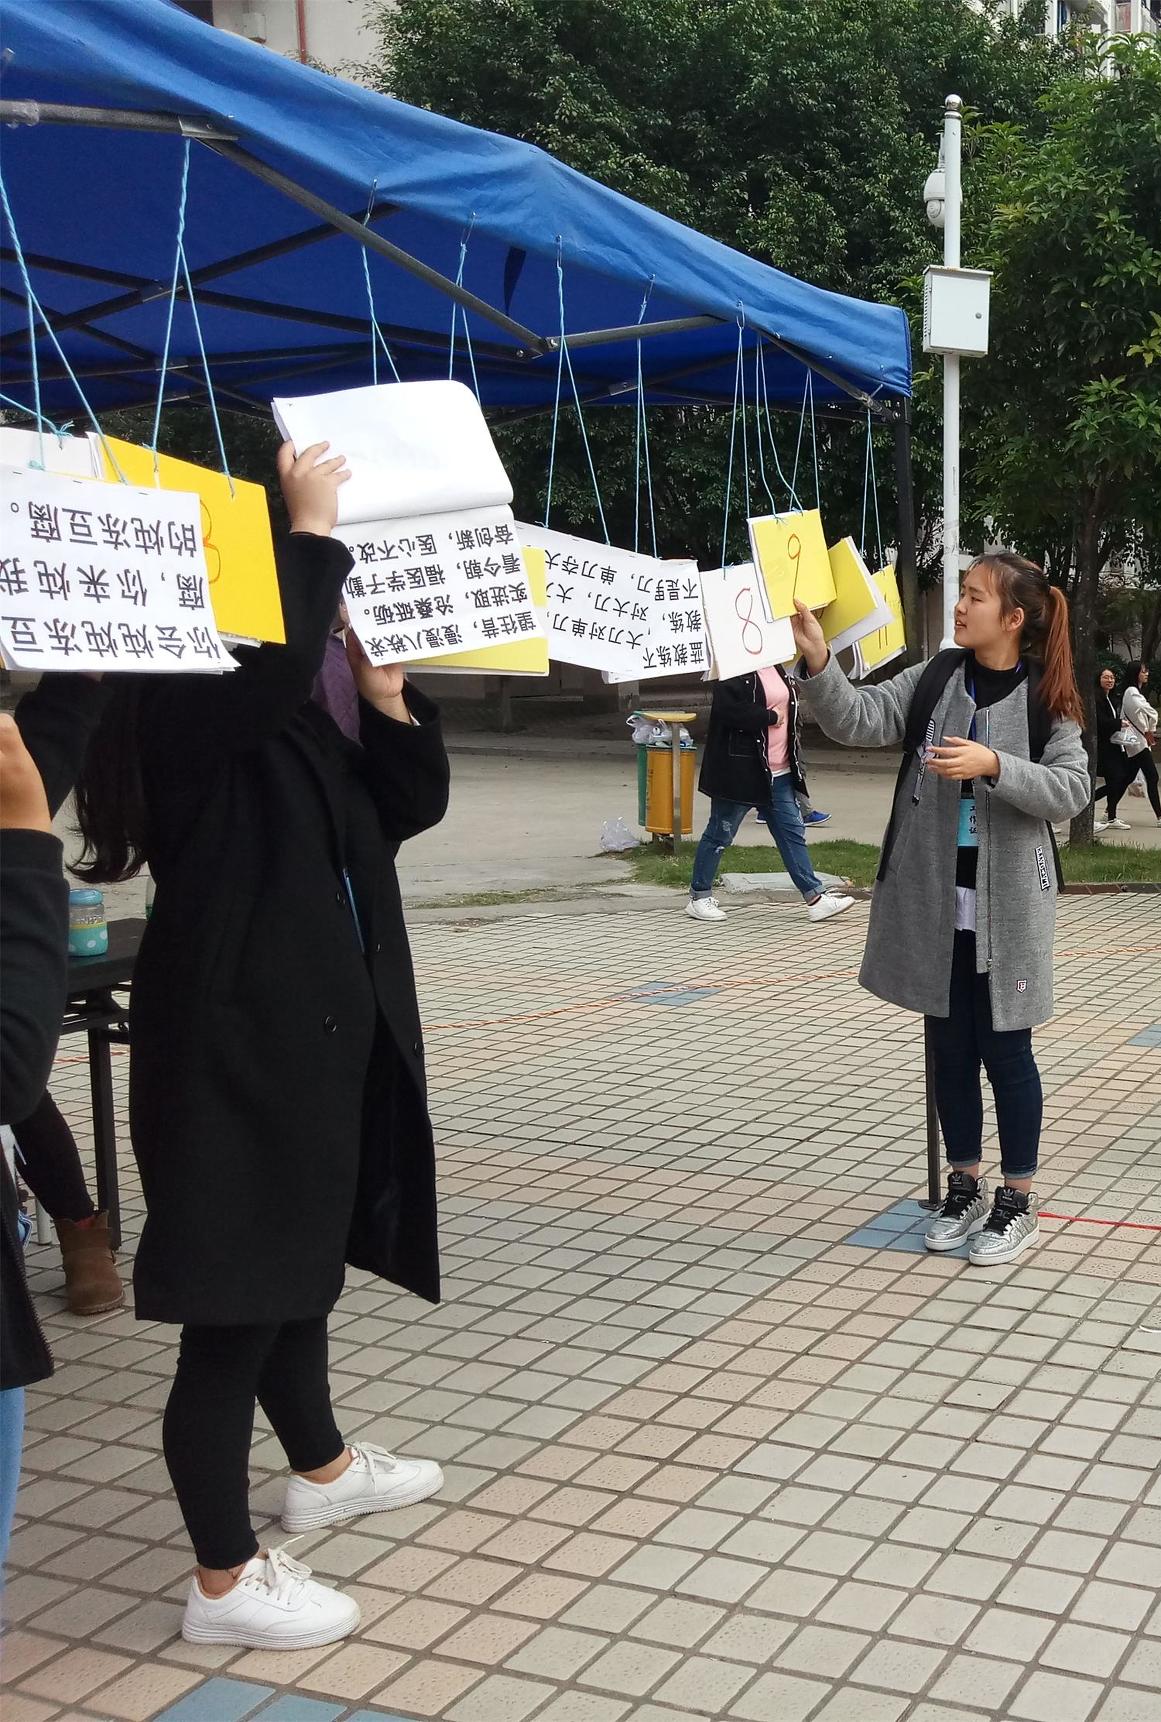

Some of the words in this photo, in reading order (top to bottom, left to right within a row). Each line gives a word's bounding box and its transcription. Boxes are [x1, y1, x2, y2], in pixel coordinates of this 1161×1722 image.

[10, 500, 198, 558] 的炖冻豆腐。
[348, 523, 514, 564] 奋创新，医心不改。
[0, 557, 205, 611] 腐，你来炖我
[344, 552, 522, 599] 看今朝，福医学子勤
[787, 533, 802, 600] 9
[363, 581, 529, 626] 实进取，沧桑砥砺。
[735, 587, 763, 655] 8
[1, 615, 221, 660] 你会炖炖冻豆
[364, 610, 538, 659] 望往昔，漫漫八秩求
[642, 641, 705, 670] 蓝教练不
